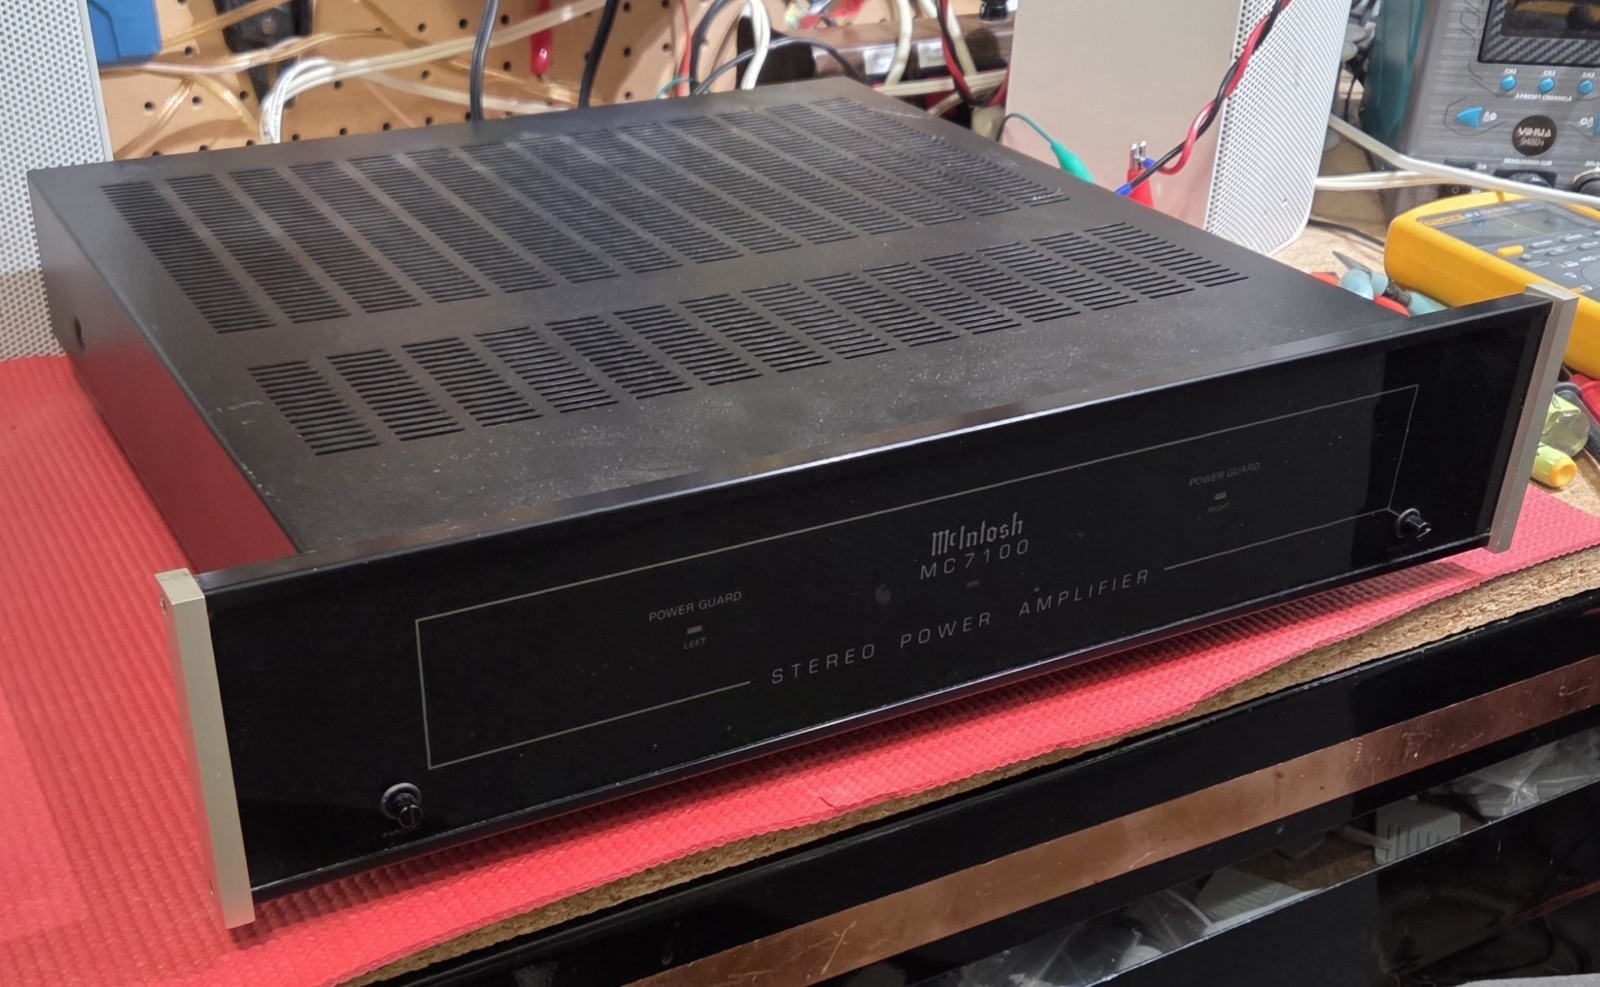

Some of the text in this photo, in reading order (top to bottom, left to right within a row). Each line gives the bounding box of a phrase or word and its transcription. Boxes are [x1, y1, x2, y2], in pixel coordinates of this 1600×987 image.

[1189, 461, 1261, 487] POWER GUARD
[931, 511, 1024, 557] McIntosh
[919, 538, 1029, 580] MC7100
[648, 591, 743, 622] POWER GUARD
[683, 637, 707, 650] LEFT
[771, 569, 1149, 685] STEREO POWER AMPLIFIER
